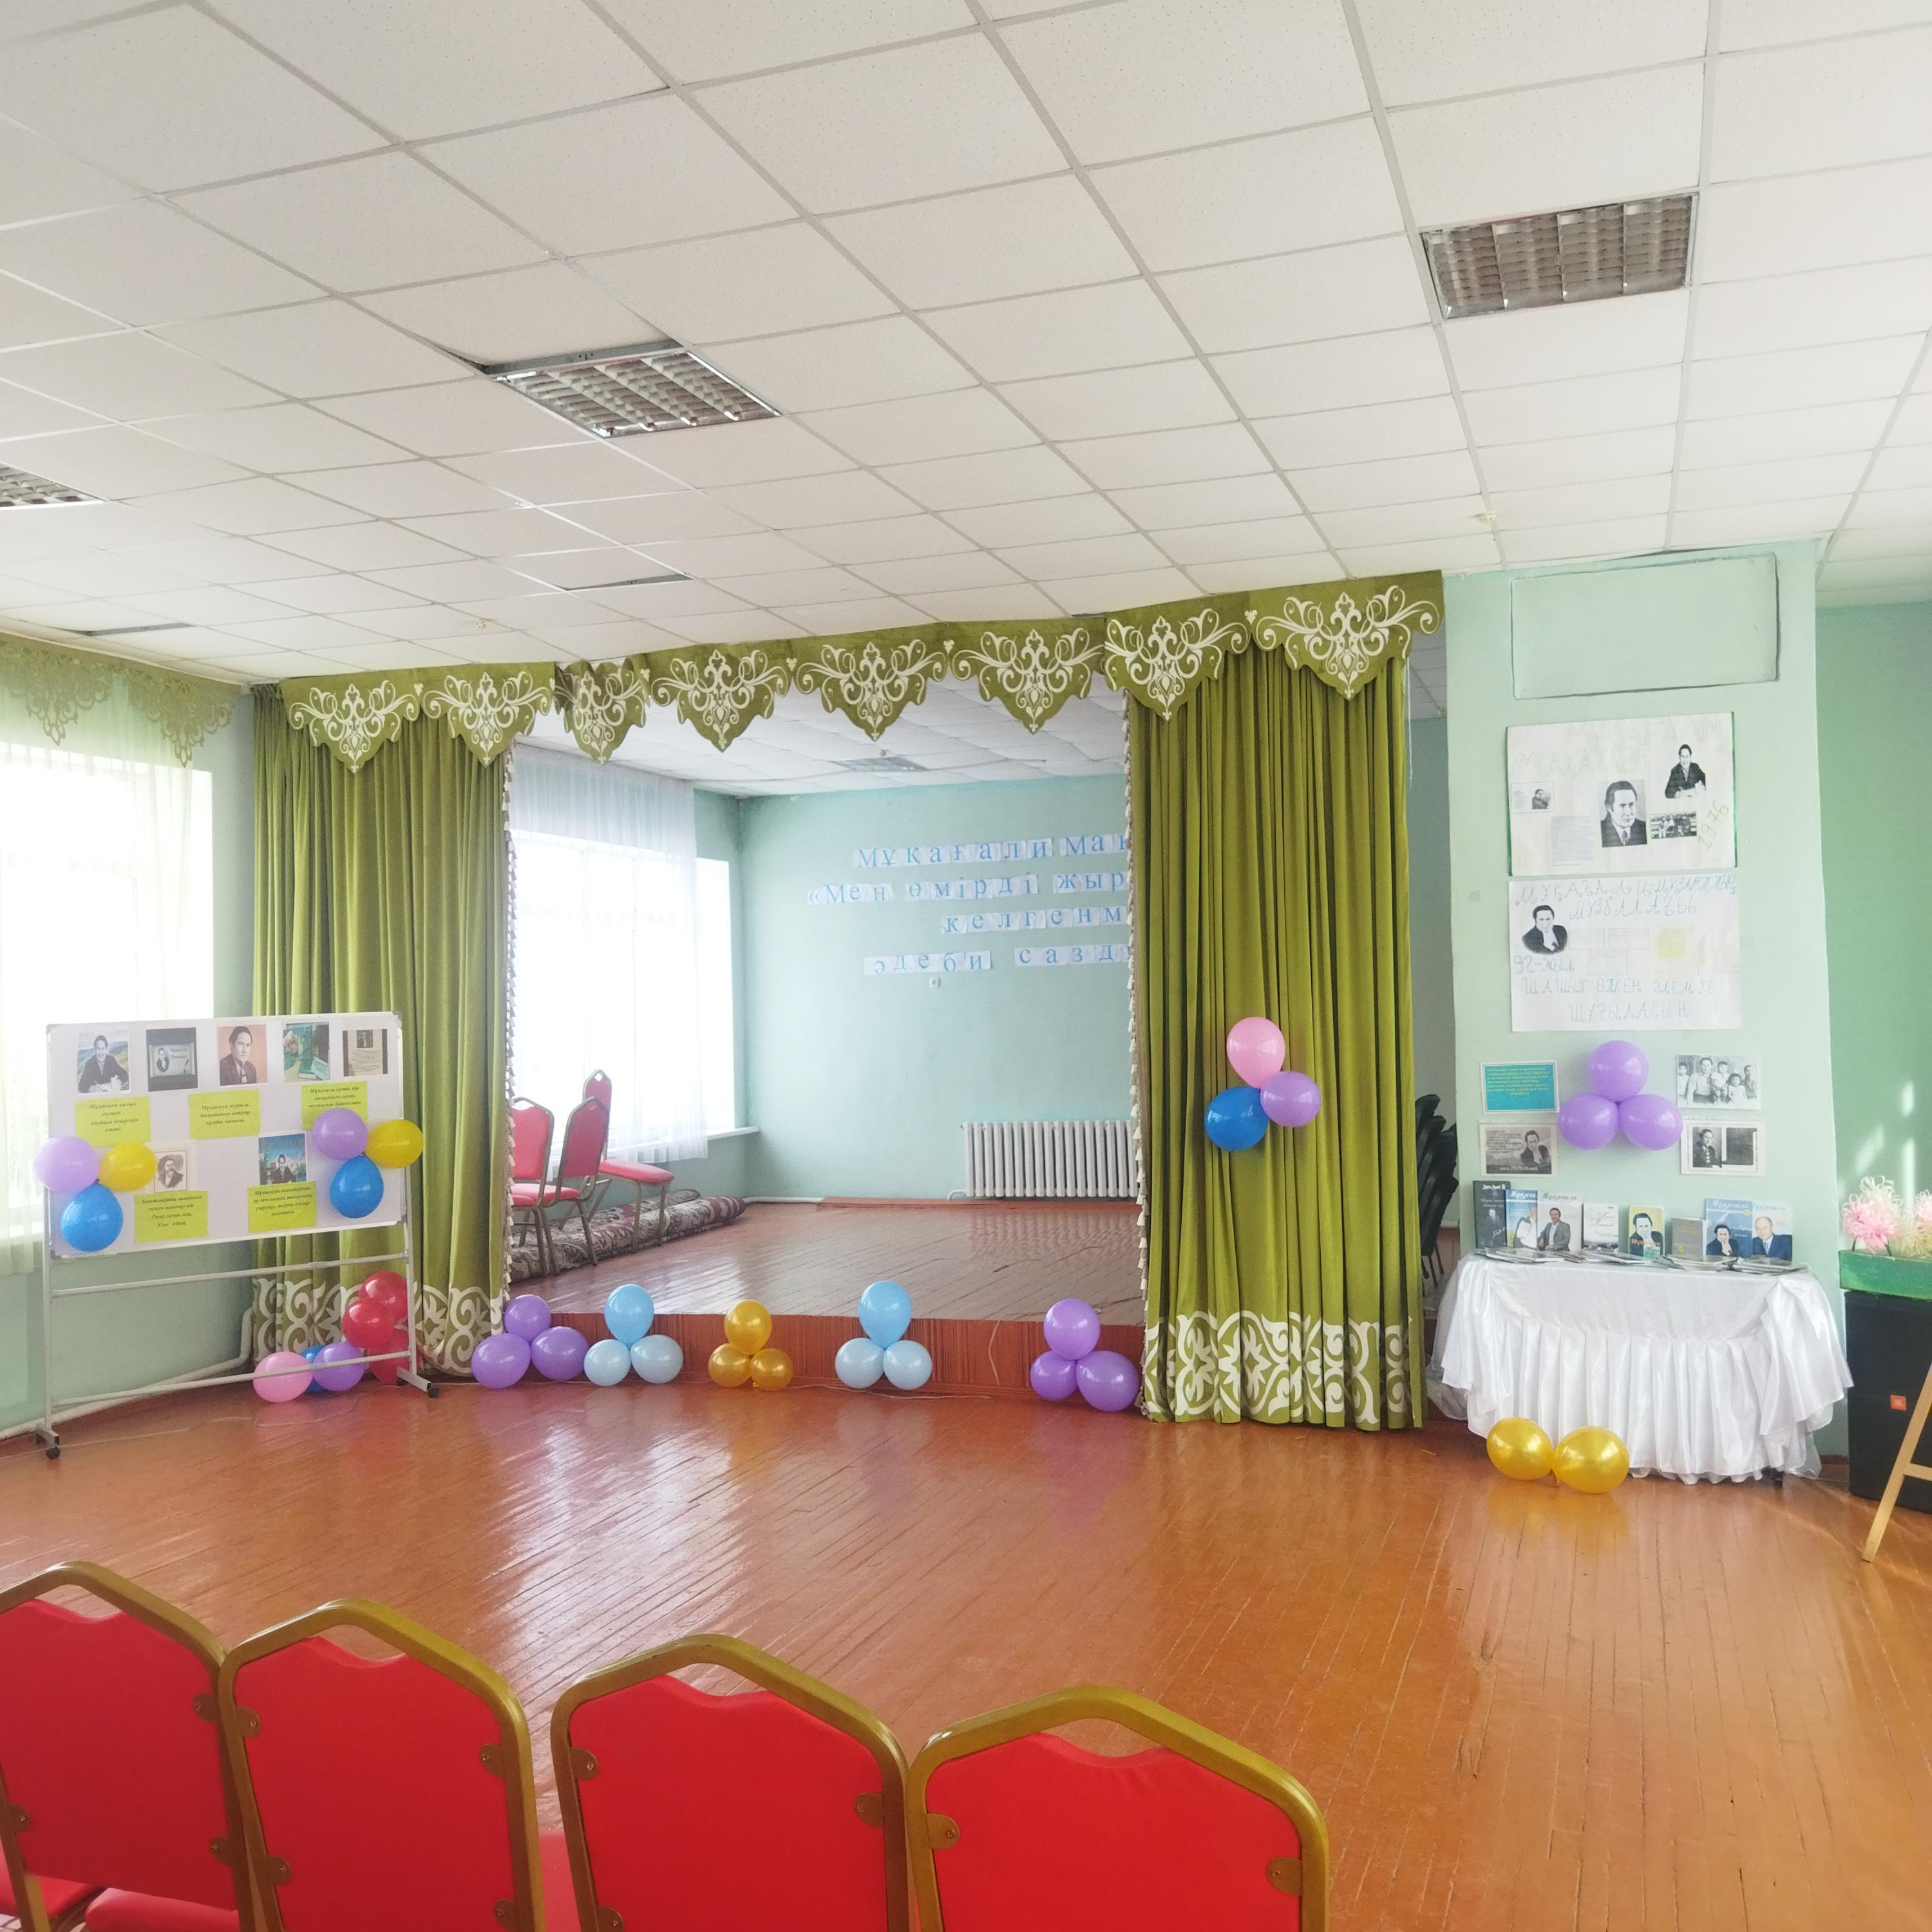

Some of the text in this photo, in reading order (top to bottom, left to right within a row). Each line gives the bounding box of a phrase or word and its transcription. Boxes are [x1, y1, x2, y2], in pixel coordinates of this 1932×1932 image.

[858, 841, 1046, 867] Мұқағали
[810, 884, 886, 904] «Мен
[909, 871, 1030, 899] өмірді
